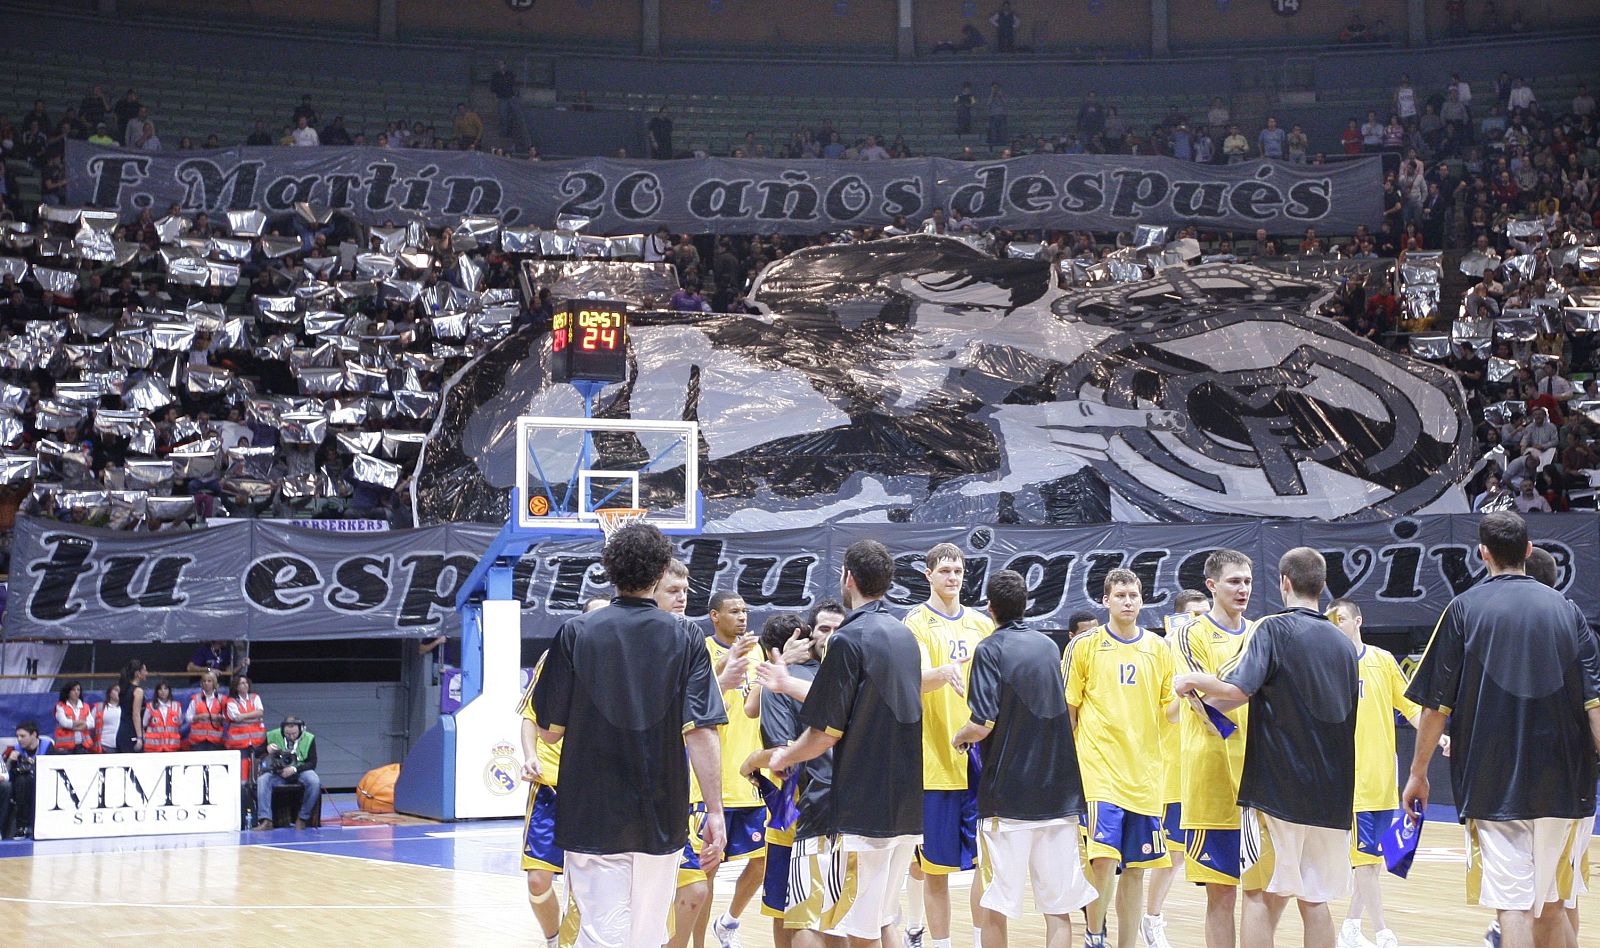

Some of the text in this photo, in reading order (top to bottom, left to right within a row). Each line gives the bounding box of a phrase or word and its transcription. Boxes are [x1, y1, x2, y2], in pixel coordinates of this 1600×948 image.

[87, 153, 155, 211] F.
[555, 169, 665, 223] 20
[687, 168, 926, 223] años
[948, 164, 1335, 226] después
[582, 327, 615, 350] 24
[24, 531, 196, 627] tu
[239, 536, 820, 629] espírtu
[949, 639, 968, 660] 25
[1119, 662, 1137, 686] 12
[47, 763, 230, 811] MMT
[73, 808, 207, 825] SEGUROS
